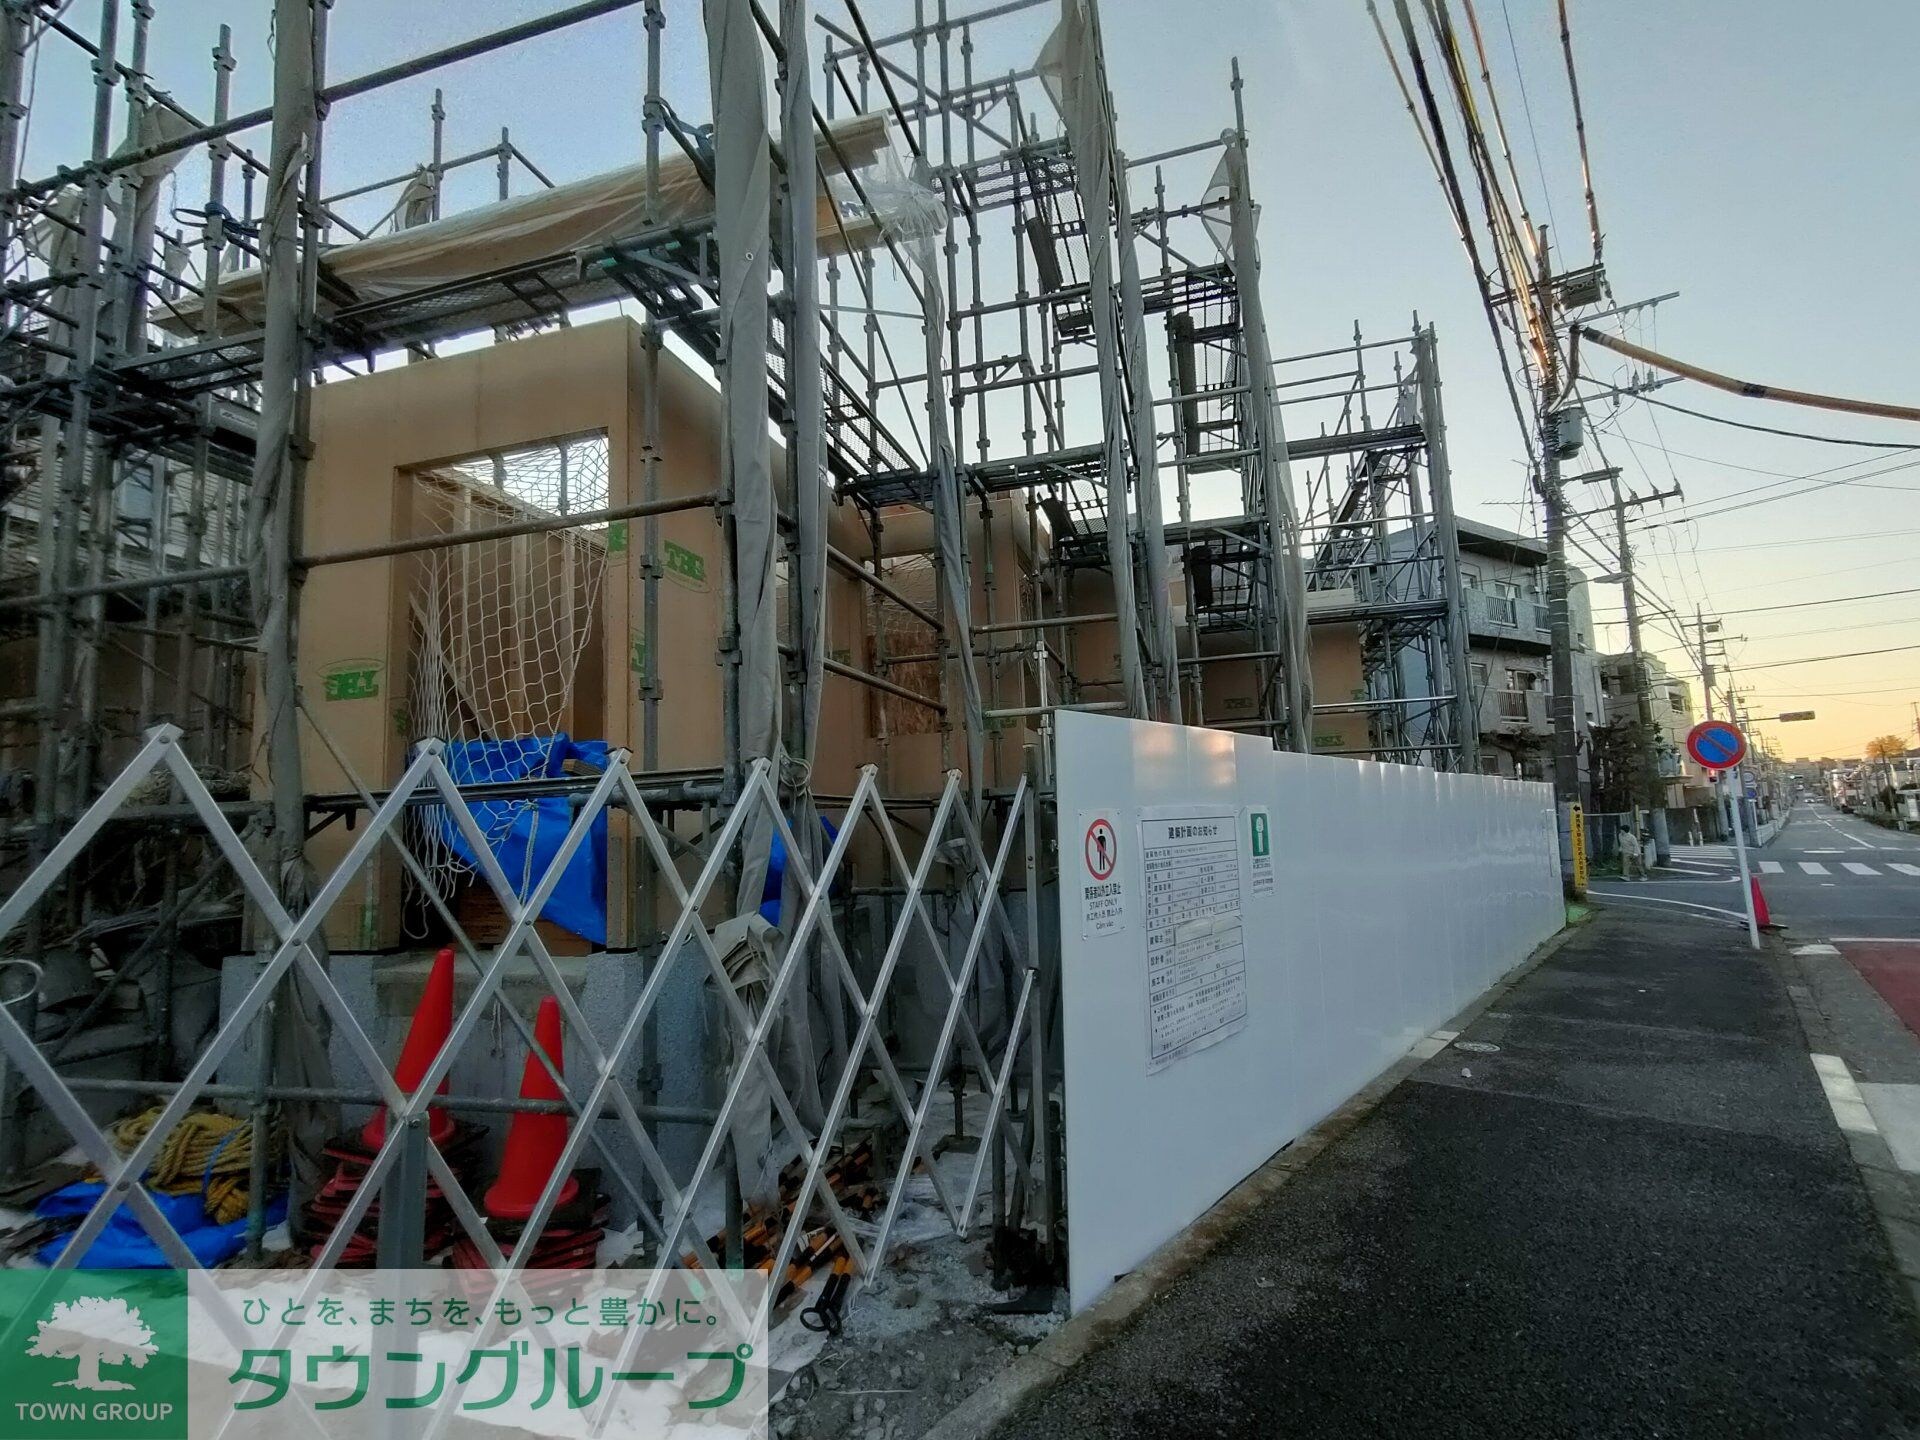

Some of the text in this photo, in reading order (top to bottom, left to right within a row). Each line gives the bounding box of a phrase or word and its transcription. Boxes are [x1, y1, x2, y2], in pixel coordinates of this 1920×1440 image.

[1168, 825, 1218, 839] 建築計画のお知らせ
[1085, 882, 1121, 900] 関係者以外立入禁止
[1089, 898, 1118, 910] STAFF ONLY
